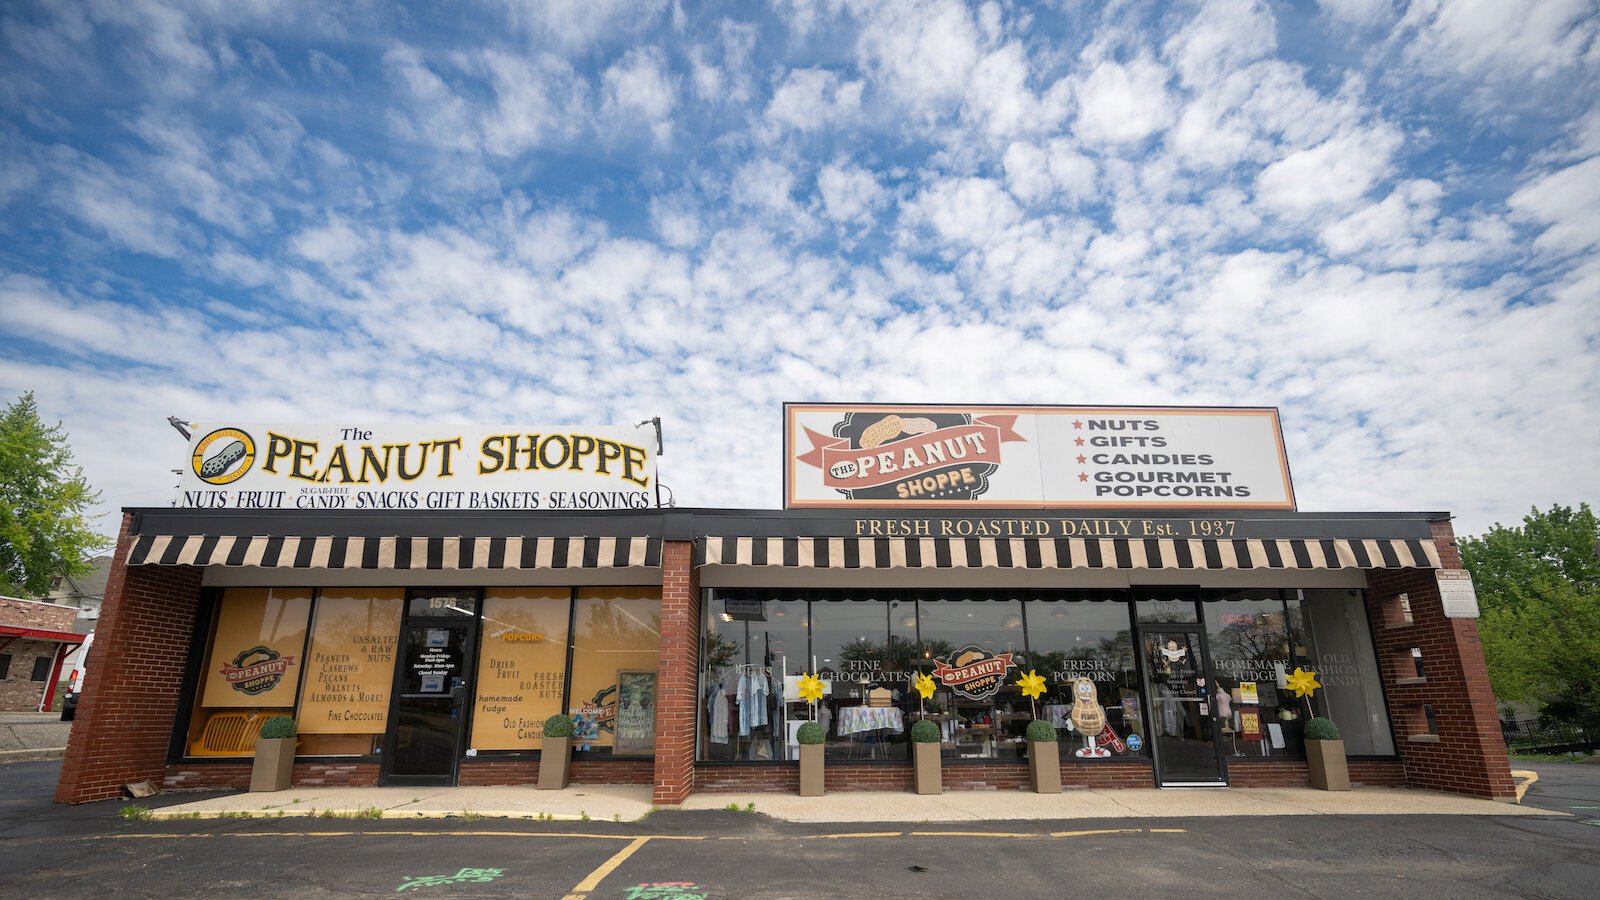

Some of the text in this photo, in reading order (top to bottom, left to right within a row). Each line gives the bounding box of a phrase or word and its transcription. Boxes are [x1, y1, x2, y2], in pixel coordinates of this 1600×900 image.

[1088, 420, 1160, 431] NUTS
[340, 427, 373, 441] The
[1090, 436, 1167, 447] GIFTS
[261, 430, 650, 488] PEANUT SHOPPE
[831, 431, 986, 479] THE PEANUT
[1092, 454, 1214, 465] CANDIES
[1094, 471, 1232, 483] GOURMET
[896, 467, 976, 499] SHOPPE
[1095, 485, 1251, 497] POPCORNS
[183, 491, 649, 509] NUTS FRUIT CANDY SNACKS GIFT BASKETS SEASONINGS
[855, 519, 1236, 536] FRESH ROASTED DAILY Est. 1937
[1152, 601, 1178, 611] 1578
[1221, 614, 1253, 625] OPEN
[502, 633, 544, 641] POPCORN
[361, 644, 393, 654] & RAW
[368, 654, 391, 663] NUTS
[490, 659, 515, 669] DRIED
[1323, 653, 1349, 664] OLD
[238, 661, 284, 679] PEANUT
[850, 660, 881, 671] FINE
[954, 661, 1002, 680] PEANUT
[1063, 660, 1105, 671] FRESH
[497, 668, 520, 679] FRUIT
[534, 672, 564, 681] FRESH
[820, 671, 911, 682] CHOCOLATES
[1054, 671, 1116, 682] POPCORN
[1233, 670, 1277, 681] FUDGE
[244, 674, 275, 688] SHOPPE
[519, 682, 563, 690] ROASTED
[964, 675, 996, 691] SHOPPE
[309, 692, 346, 702] ALMONDS
[358, 692, 383, 702] MORE!
[478, 694, 523, 702] homemade
[539, 690, 562, 698] NUTS
[482, 704, 507, 714] fudge
[328, 710, 384, 721] FINE CHOCOLATES
[503, 717, 516, 729] OLD
[517, 728, 544, 739] CANDIES
